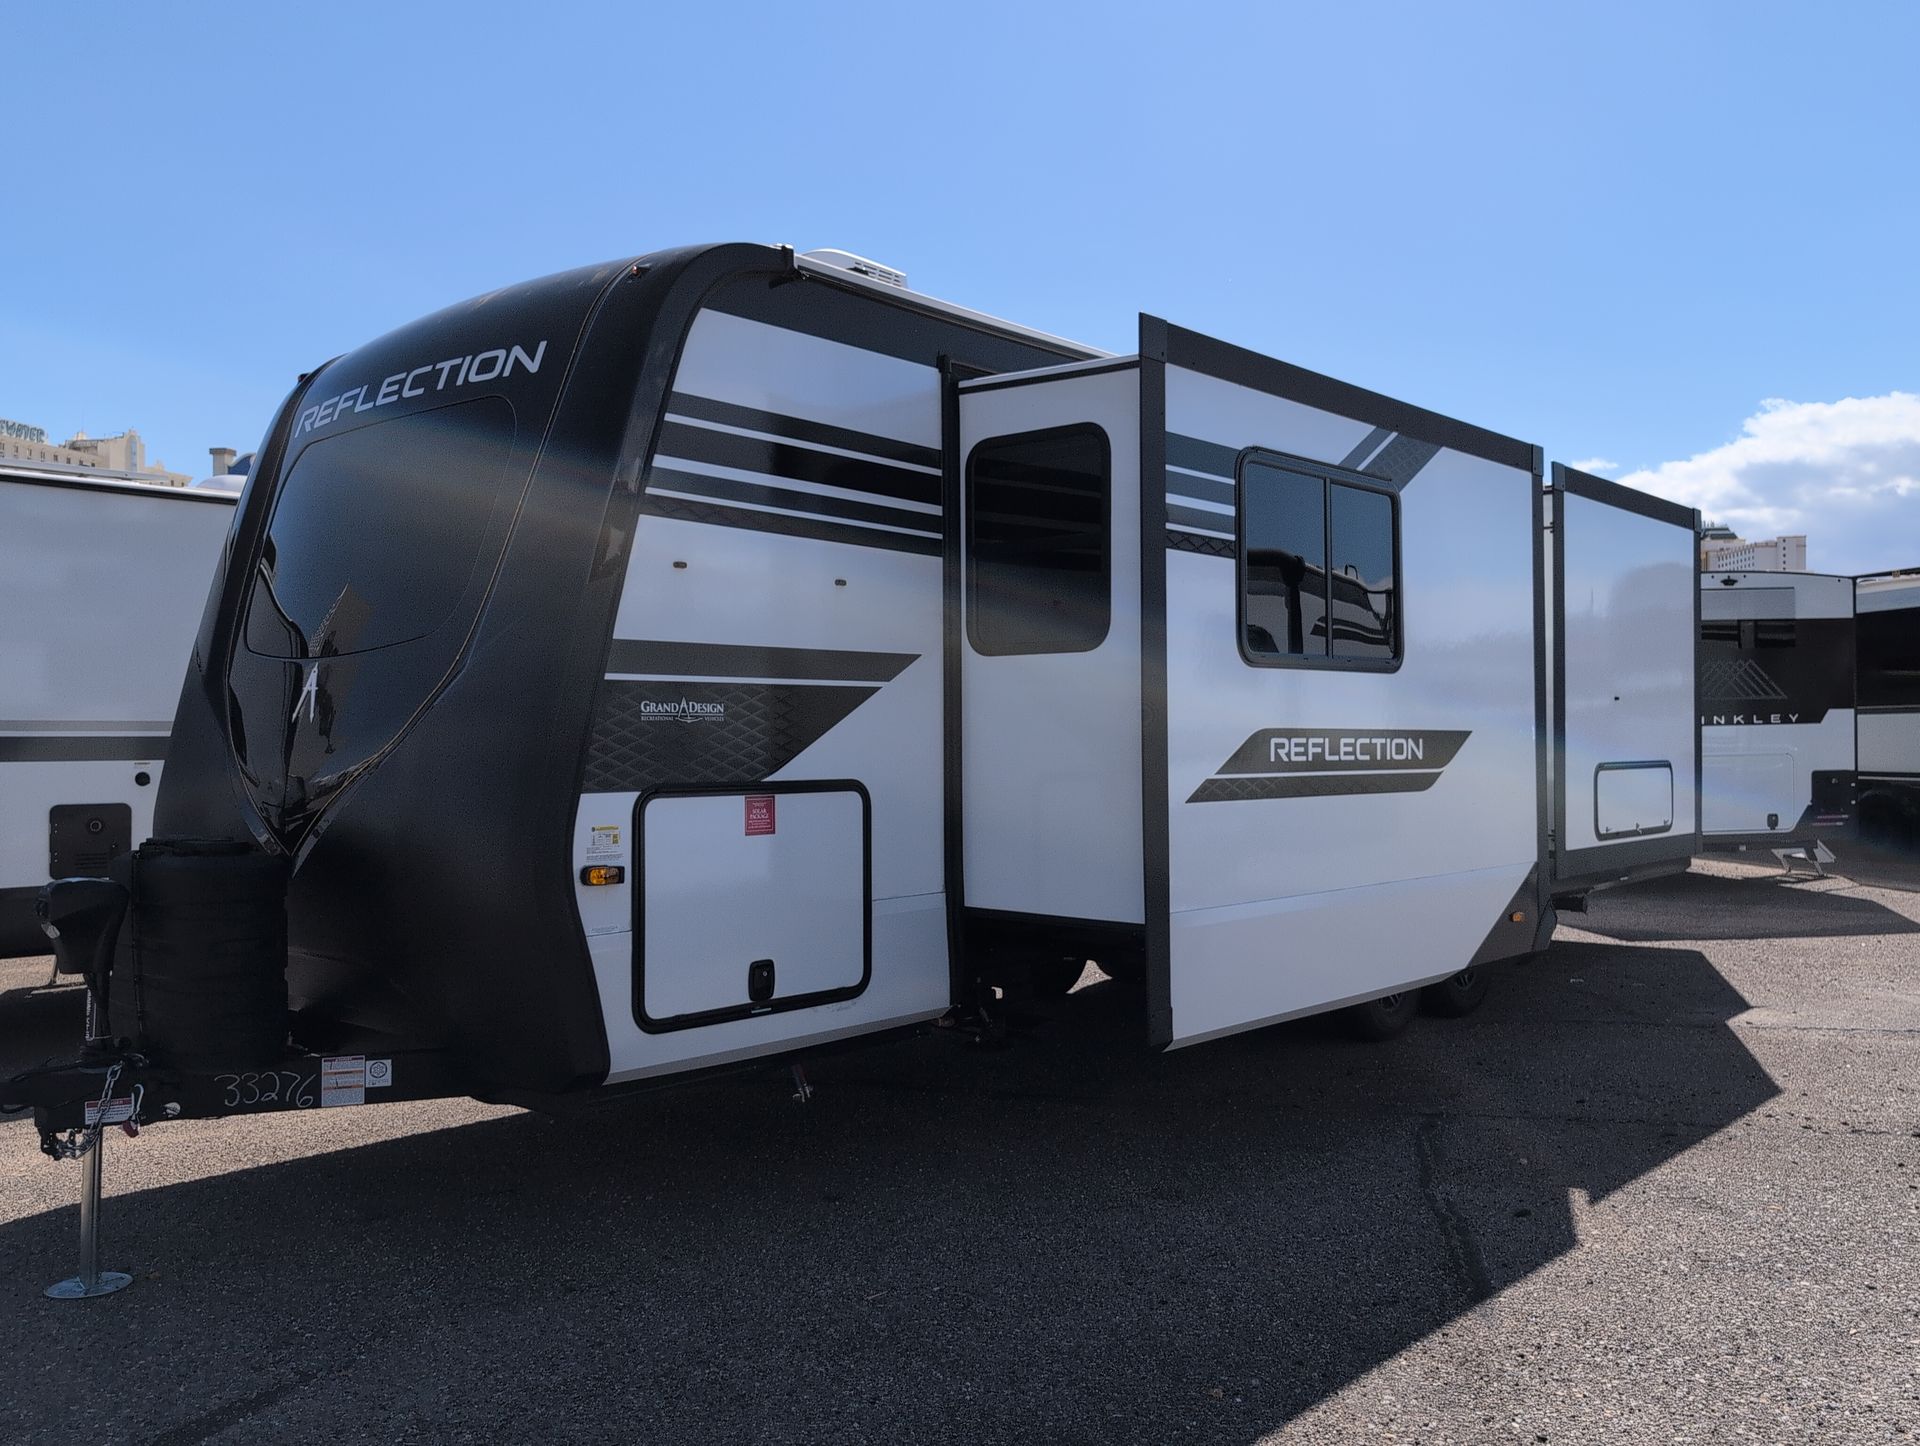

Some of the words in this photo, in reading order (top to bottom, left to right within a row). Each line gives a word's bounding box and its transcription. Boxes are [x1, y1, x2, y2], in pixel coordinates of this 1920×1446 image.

[295, 340, 547, 438] REFLECTION
[640, 700, 680, 713] GRAND
[688, 701, 725, 713] DESIGN
[1269, 737, 1424, 762] REFLECTION
[214, 1071, 317, 1108] 33276
